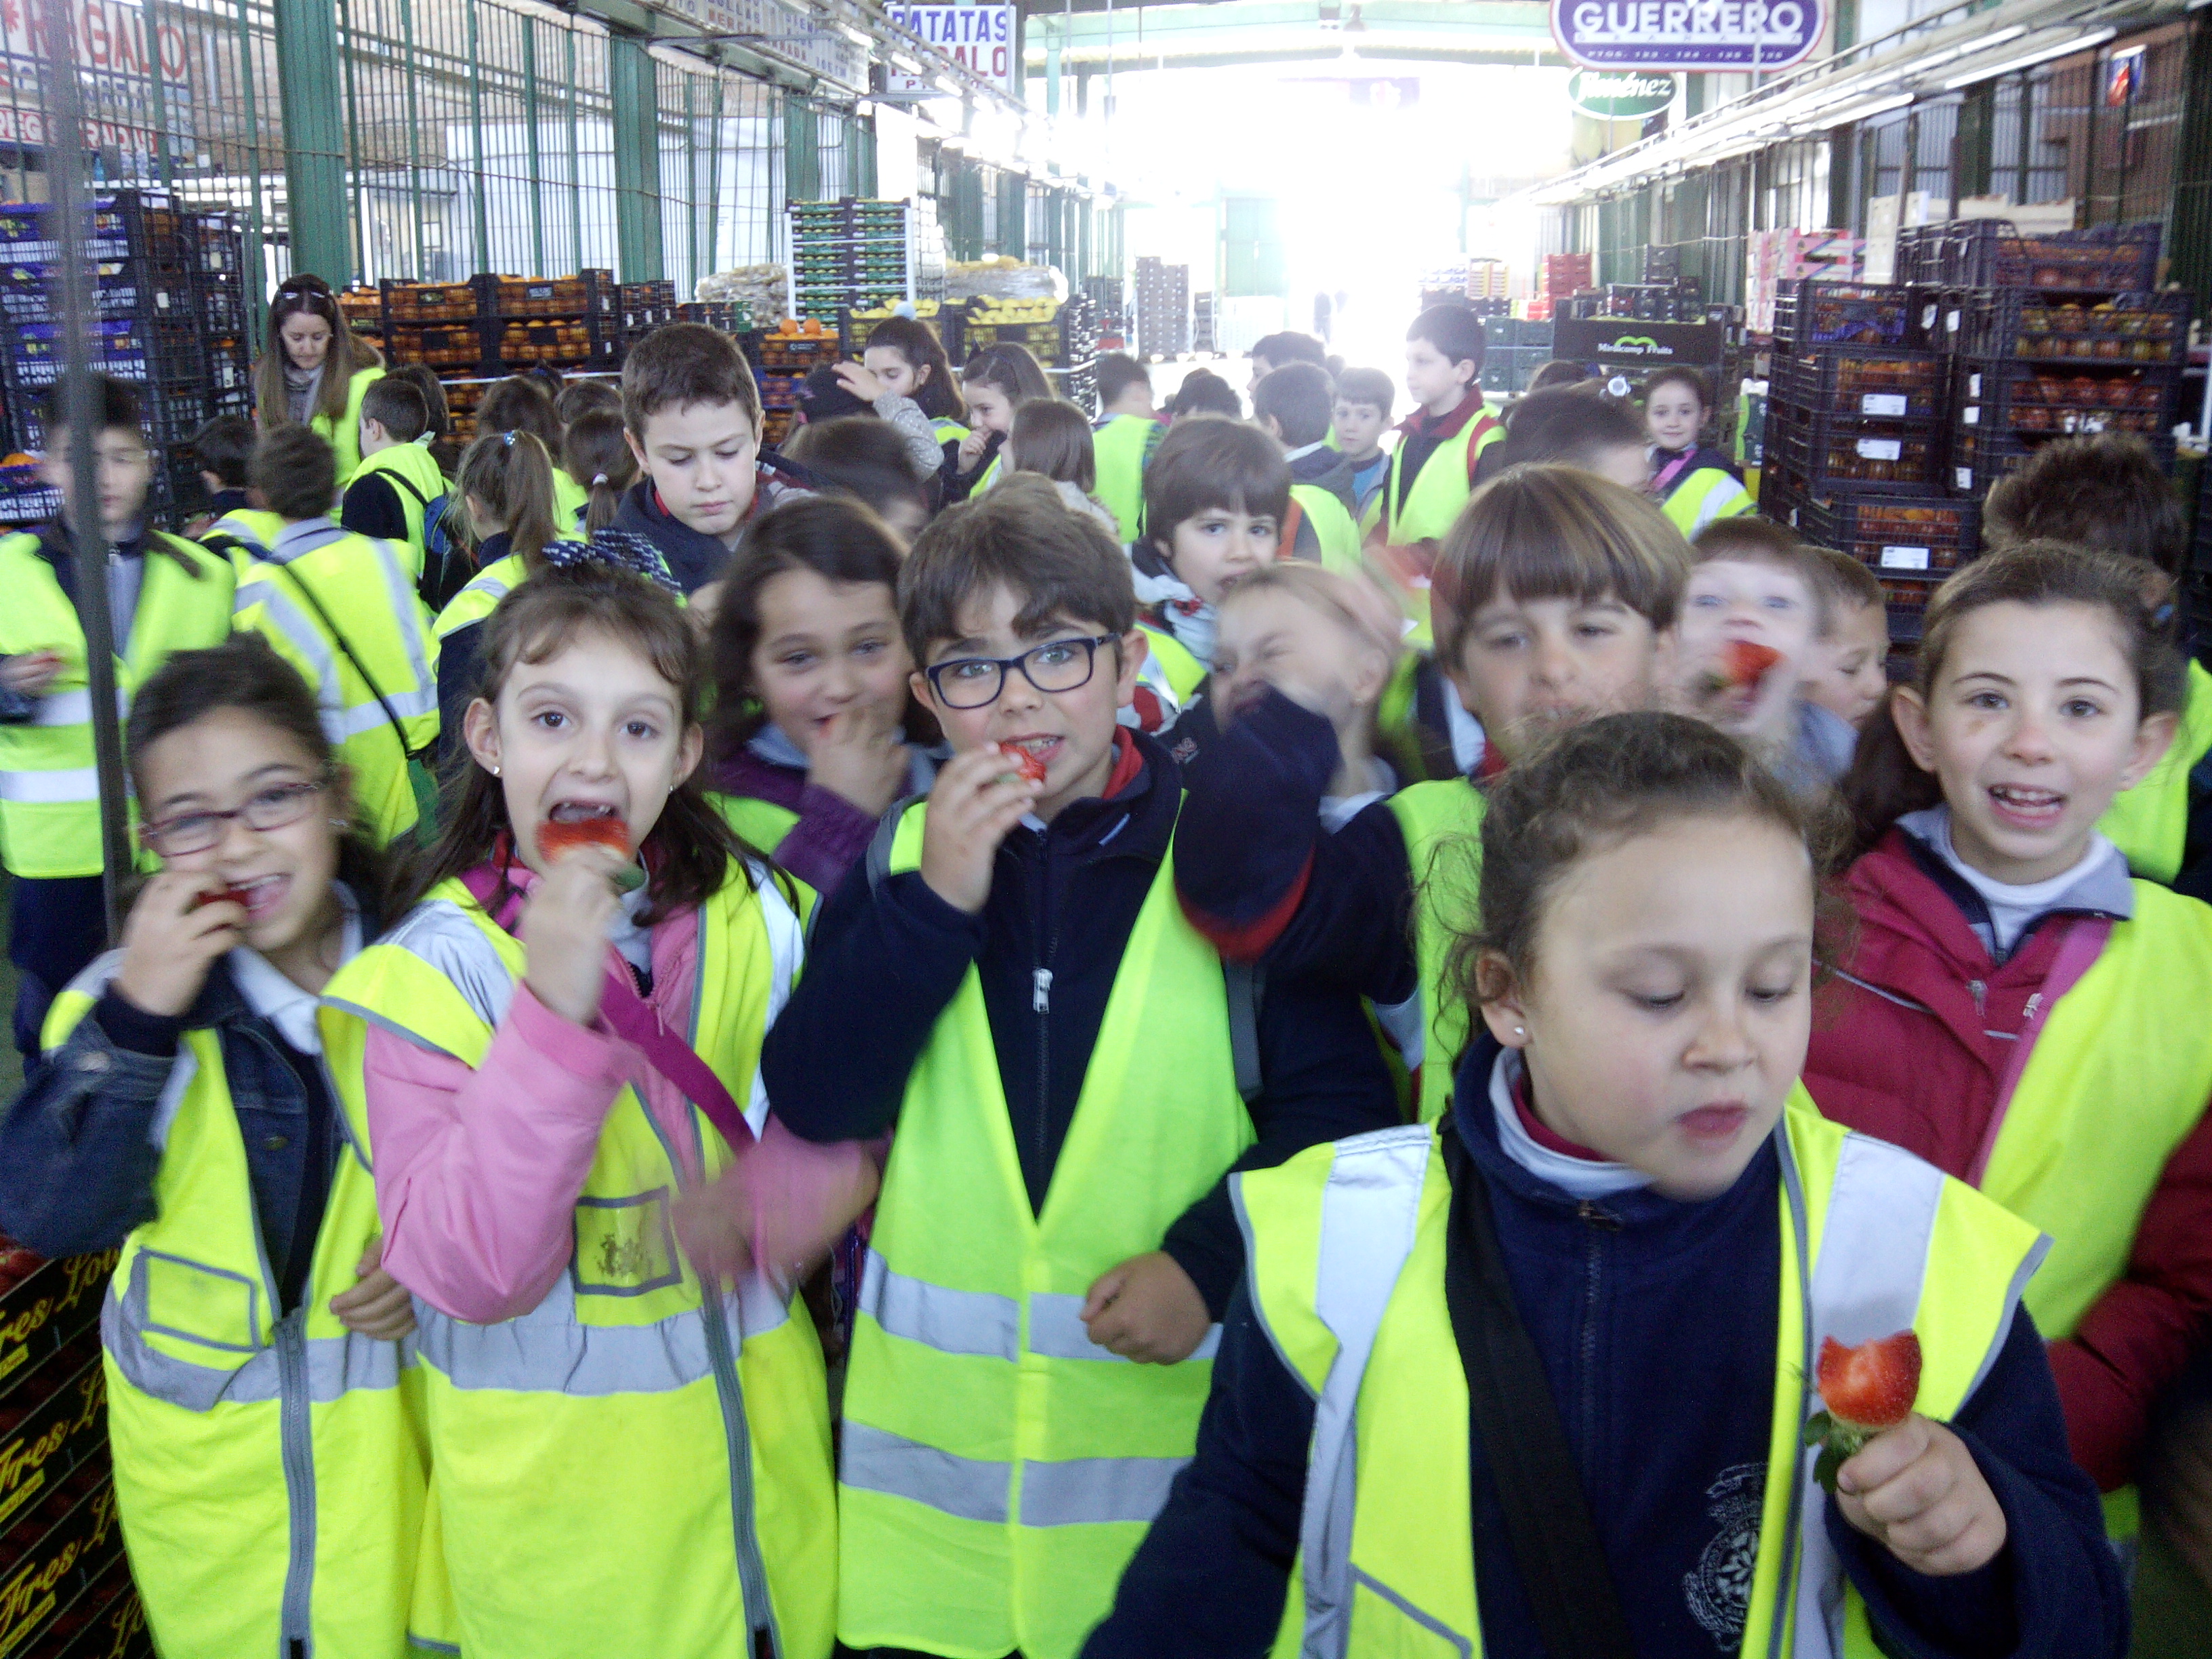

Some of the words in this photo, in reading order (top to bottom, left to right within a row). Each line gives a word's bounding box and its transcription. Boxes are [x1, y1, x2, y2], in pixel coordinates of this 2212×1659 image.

[893, 9, 1008, 42] PATATAS
[1574, 1, 1803, 33] GUERRERO
[22, 0, 186, 78] RGALO
